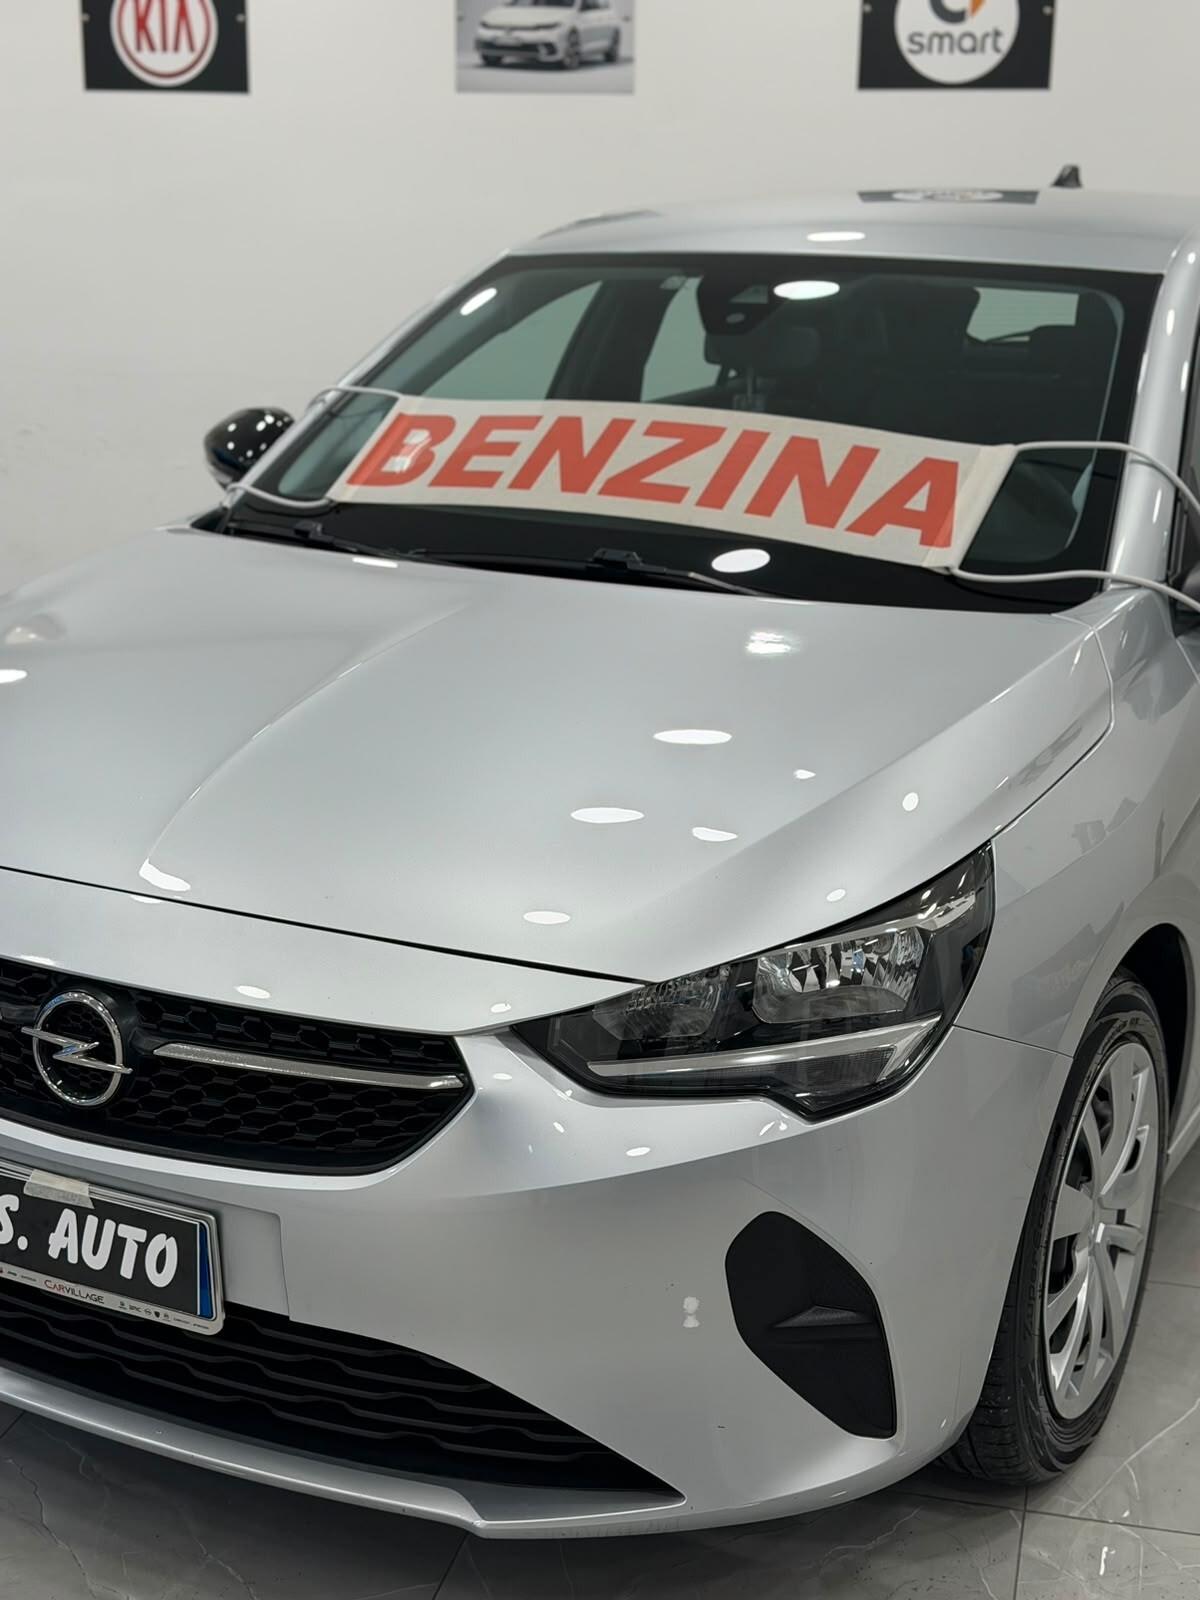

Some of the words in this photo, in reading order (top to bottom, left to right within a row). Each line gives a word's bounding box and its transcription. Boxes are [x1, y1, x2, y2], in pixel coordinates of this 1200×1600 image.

[133, 0, 196, 53] KIA
[907, 28, 1004, 55] smart
[346, 412, 960, 549] BENZINA
[48, 1208, 179, 1288] AUTO
[44, 1279, 105, 1305] CARVILLAGE
